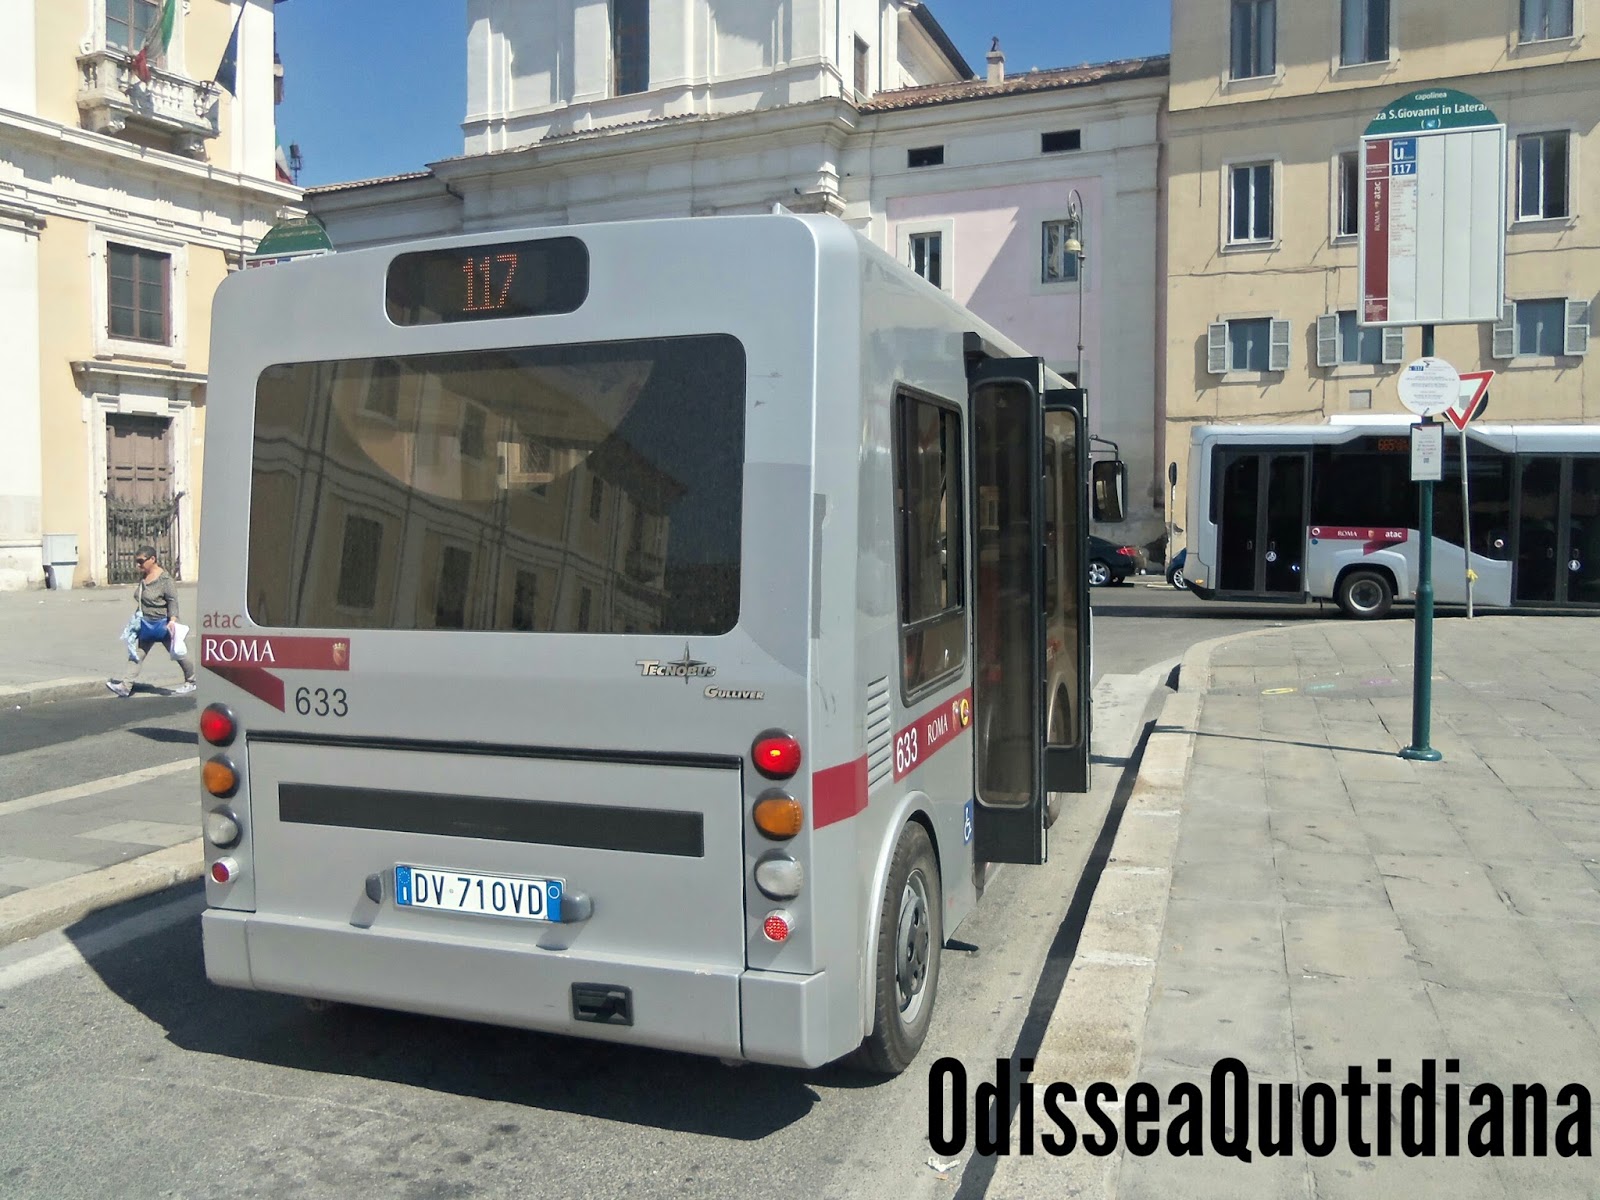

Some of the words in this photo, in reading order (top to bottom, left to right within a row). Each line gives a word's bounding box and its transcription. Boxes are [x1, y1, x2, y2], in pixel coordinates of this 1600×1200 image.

[1414, 91, 1448, 101] capolinea
[1373, 111, 1387, 121] za
[1388, 105, 1440, 120] S.Giovanni
[1442, 104, 1452, 115] in
[1393, 163, 1412, 175] 117
[1374, 181, 1382, 199] atac
[462, 253, 517, 311] 117
[1384, 530, 1403, 538] atac
[202, 611, 243, 628] atac
[205, 638, 276, 662] ROMA
[295, 686, 349, 717] 633
[896, 727, 918, 773] 633
[927, 713, 949, 746] ROMA
[415, 872, 445, 905] DV
[457, 877, 544, 915] 710VD
